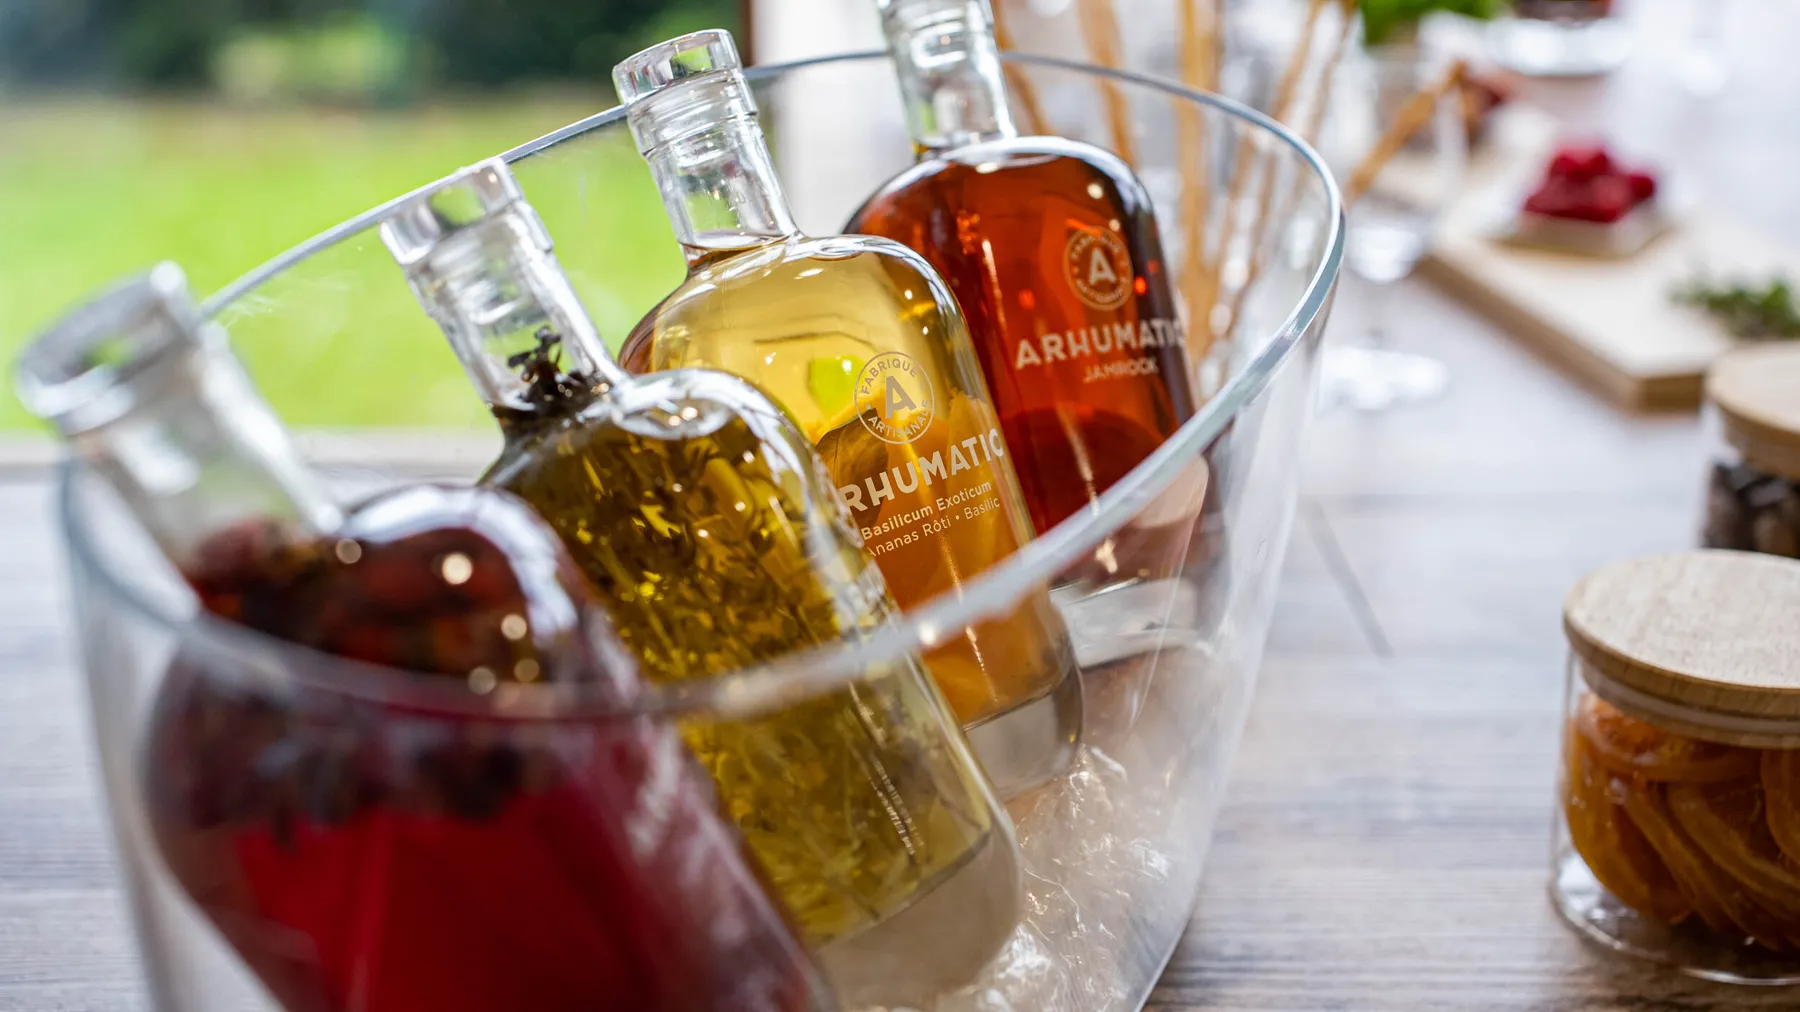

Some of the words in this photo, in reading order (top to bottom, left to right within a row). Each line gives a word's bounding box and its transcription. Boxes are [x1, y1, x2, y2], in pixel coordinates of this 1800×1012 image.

[1089, 247, 1117, 286] A
[861, 358, 918, 395] FABRIQUE
[885, 375, 917, 419] A
[868, 399, 931, 438] ARTISANALE
[838, 428, 1004, 512] RHUMATIC
[860, 504, 934, 541] Basilicum
[935, 481, 992, 512] Exoticum
[922, 514, 952, 537] Rôti
[963, 497, 1001, 520] Basilic
